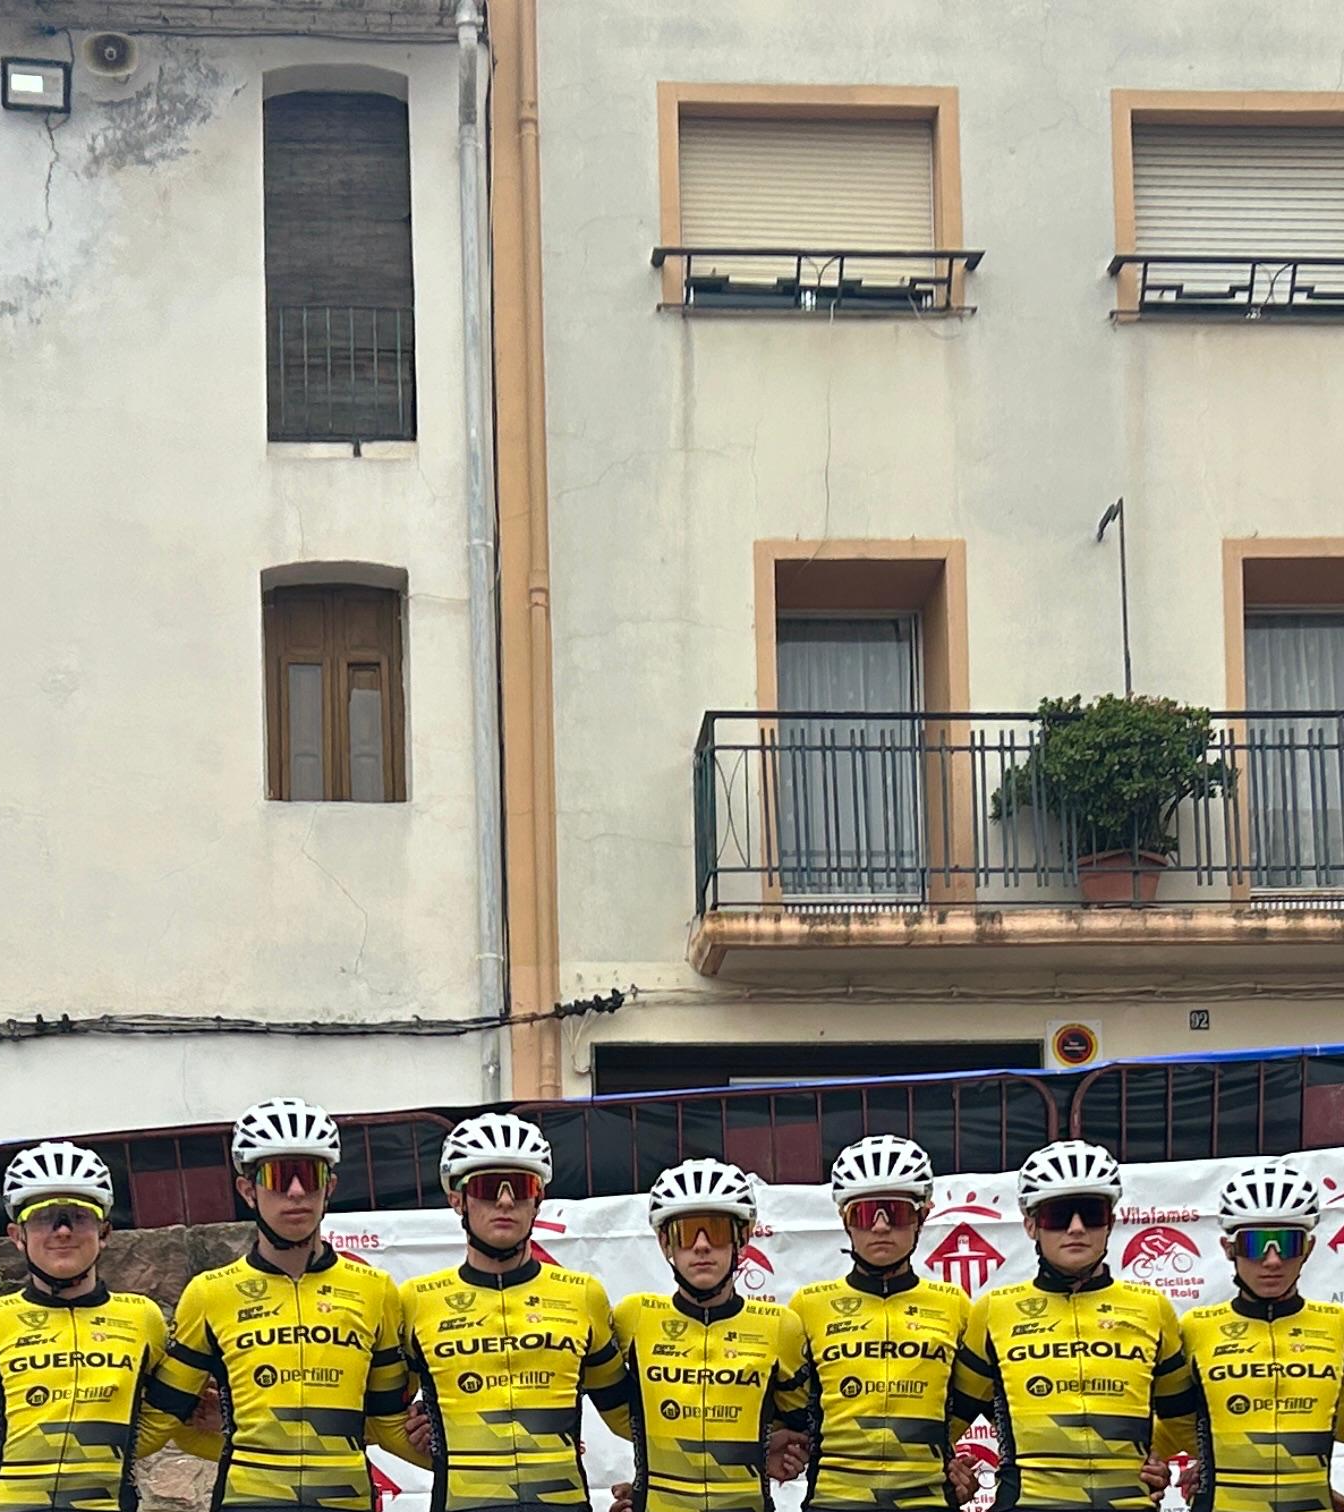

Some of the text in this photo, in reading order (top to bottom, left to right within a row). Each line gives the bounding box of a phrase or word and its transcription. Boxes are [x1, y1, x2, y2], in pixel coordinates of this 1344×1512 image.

[1192, 1012, 1209, 1028] 92
[1120, 1204, 1200, 1224] Vilafamés
[1155, 1277, 1204, 1286] Ciclista
[1171, 1289, 1199, 1298] Roig
[236, 1325, 362, 1349] GUEROLA
[434, 1332, 578, 1358] GUEROLA
[8, 1352, 133, 1372] GUEROLA
[822, 1341, 946, 1363] GUEROLA
[1007, 1341, 1147, 1363] GUEROLA
[647, 1366, 761, 1387] GUEROLA
[1209, 1363, 1337, 1381] GUEROLA
